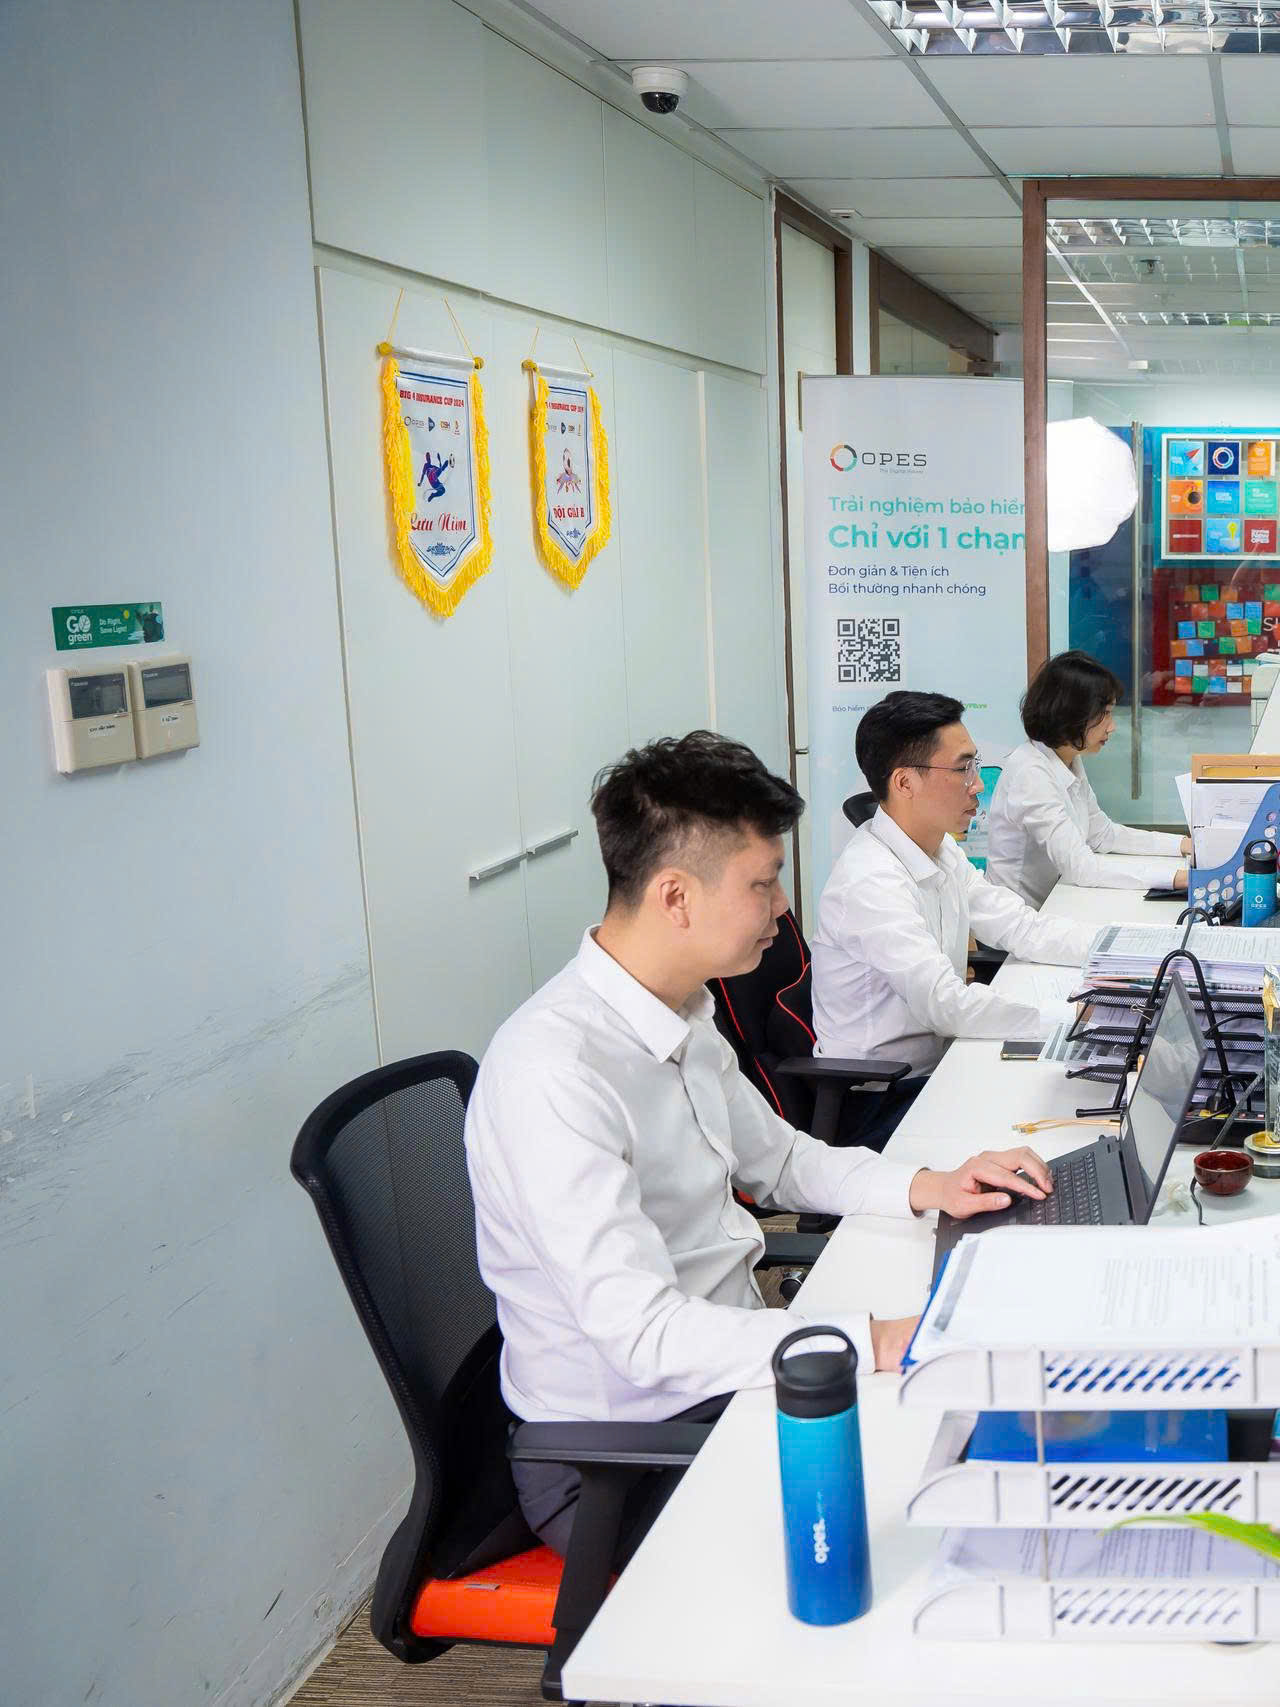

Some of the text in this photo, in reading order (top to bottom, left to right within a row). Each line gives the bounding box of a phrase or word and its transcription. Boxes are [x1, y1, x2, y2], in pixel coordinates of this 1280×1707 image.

[861, 452, 928, 467] OPES
[828, 495, 864, 513] Trải
[869, 497, 945, 517] nghiệm
[950, 497, 986, 515] bảo
[828, 522, 879, 549] Chỉ
[886, 524, 930, 549] với
[938, 527, 948, 549] 1
[828, 564, 950, 579] Đơn giản & Tiện ích
[902, 583, 944, 594] nhanh
[946, 583, 987, 597] chóng
[68, 633, 92, 646] green
